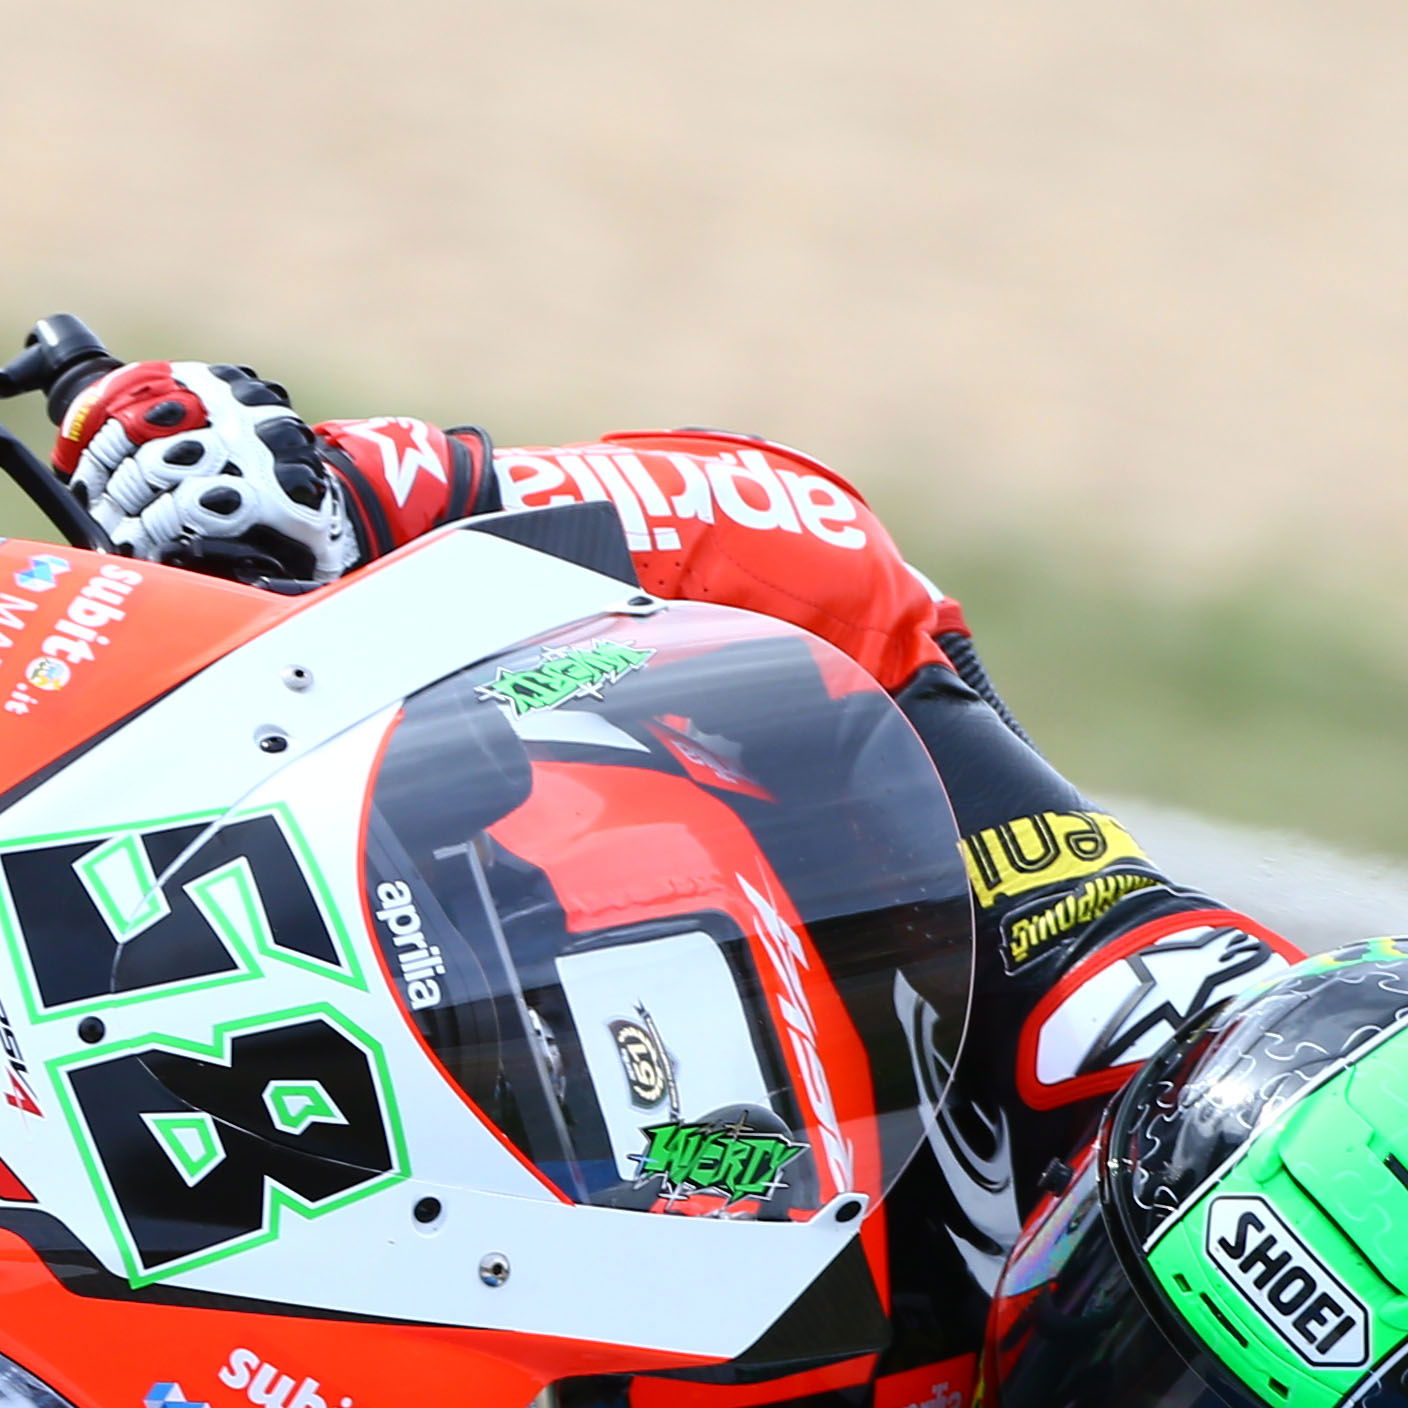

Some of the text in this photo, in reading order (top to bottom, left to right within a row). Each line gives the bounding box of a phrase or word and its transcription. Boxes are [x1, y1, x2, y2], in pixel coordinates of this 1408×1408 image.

[494, 448, 867, 551] aprilia
[968, 811, 1107, 890] eni
[377, 880, 442, 1010] aprilia
[1217, 1210, 1357, 1355] SHOEI
